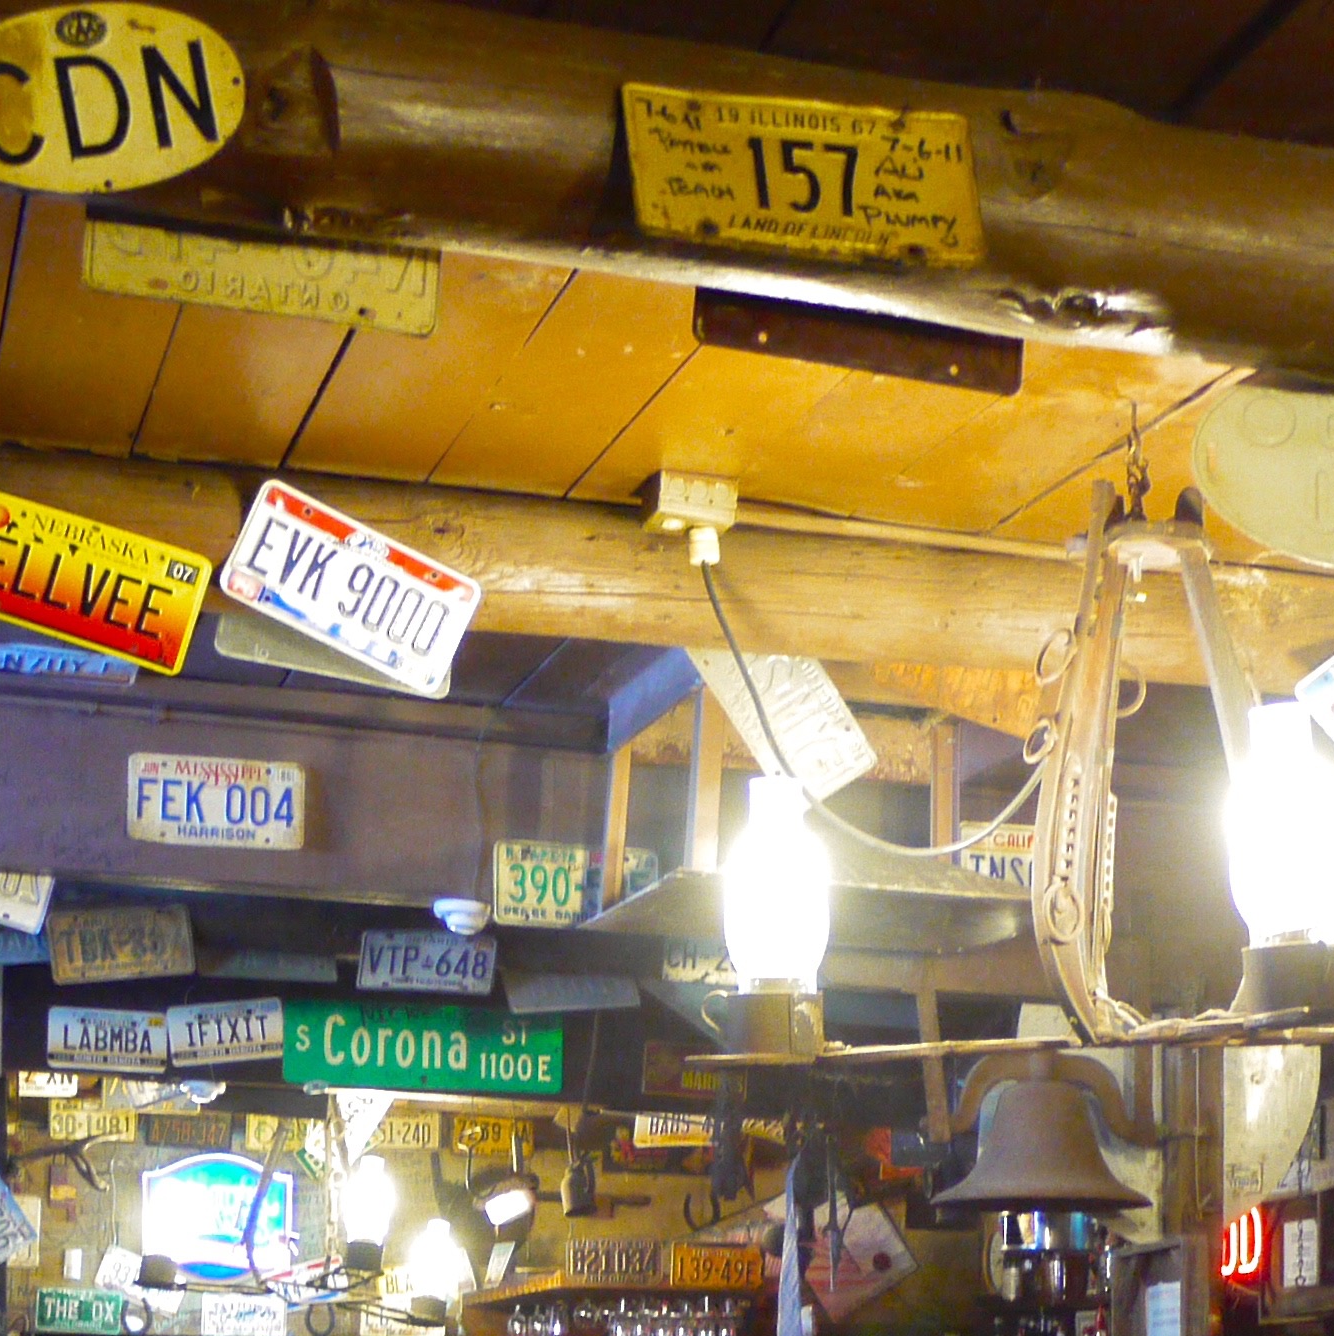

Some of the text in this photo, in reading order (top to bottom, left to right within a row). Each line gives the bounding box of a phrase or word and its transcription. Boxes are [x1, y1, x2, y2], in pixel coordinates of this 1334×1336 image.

[749, 109, 841, 133] ILLINOIS
[747, 136, 859, 218] 157
[728, 214, 779, 233] LAND
[30, 511, 152, 564] NEBRASKA
[172, 562, 195, 581] 07
[247, 517, 452, 657] EVK 9000
[175, 759, 264, 786] MISSISSIPPI
[135, 776, 297, 830] FEK 004
[176, 824, 257, 842] HARRISON
[368, 946, 489, 981] VTP 648
[62, 1022, 154, 1056] LABMBA
[185, 1014, 269, 1049] IFIXIT
[322, 1013, 469, 1073] Corona
[500, 1019, 529, 1048] ST
[478, 1051, 553, 1083] 1100 E
[43, 1297, 117, 1323] THE OX
